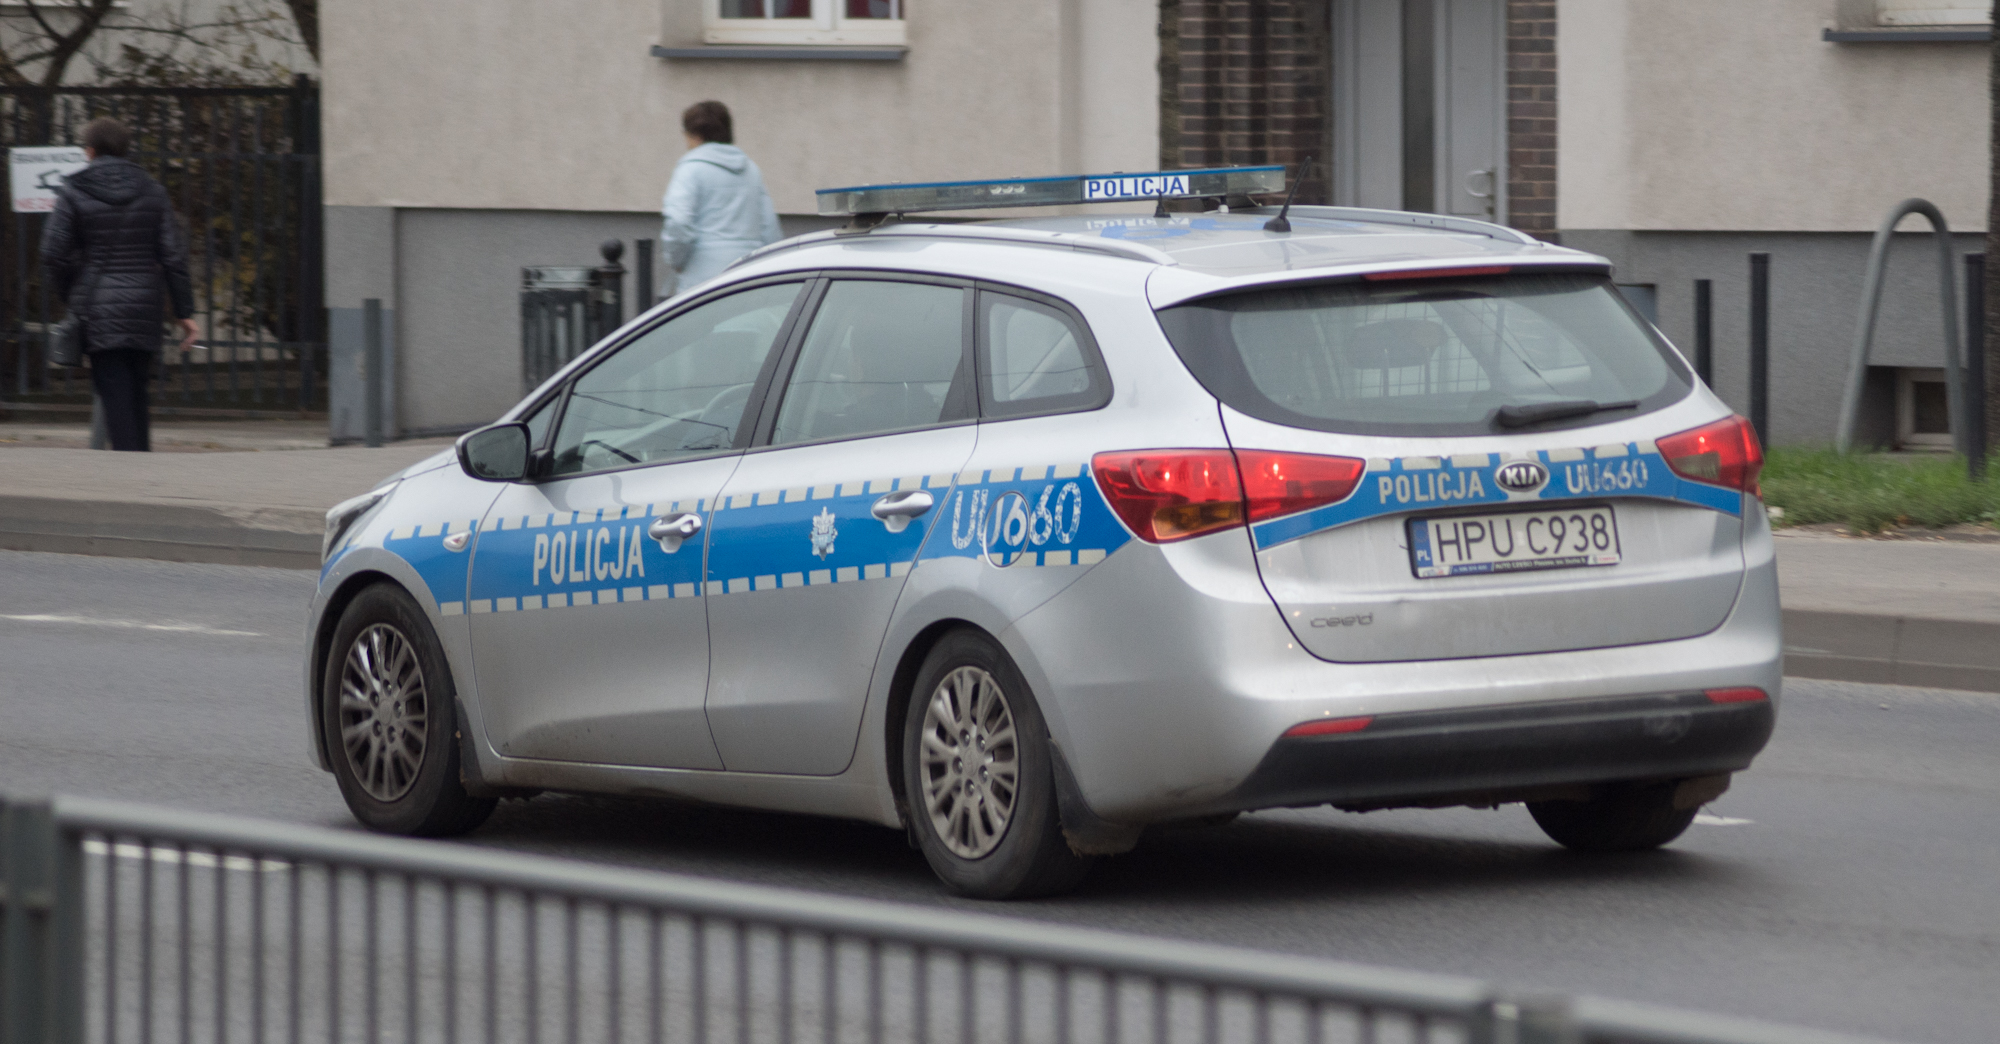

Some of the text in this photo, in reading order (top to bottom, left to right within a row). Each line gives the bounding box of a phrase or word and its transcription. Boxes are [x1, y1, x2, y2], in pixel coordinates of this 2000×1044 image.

[1088, 176, 1185, 198] POLICJA
[1378, 470, 1486, 504] POLICJA
[1505, 465, 1541, 486] KIA
[1565, 459, 1648, 494] UU660
[952, 481, 1082, 549] UU660
[1435, 514, 1611, 562] HPU C938
[533, 525, 645, 586] POLICJA
[1416, 549, 1431, 562] PL
